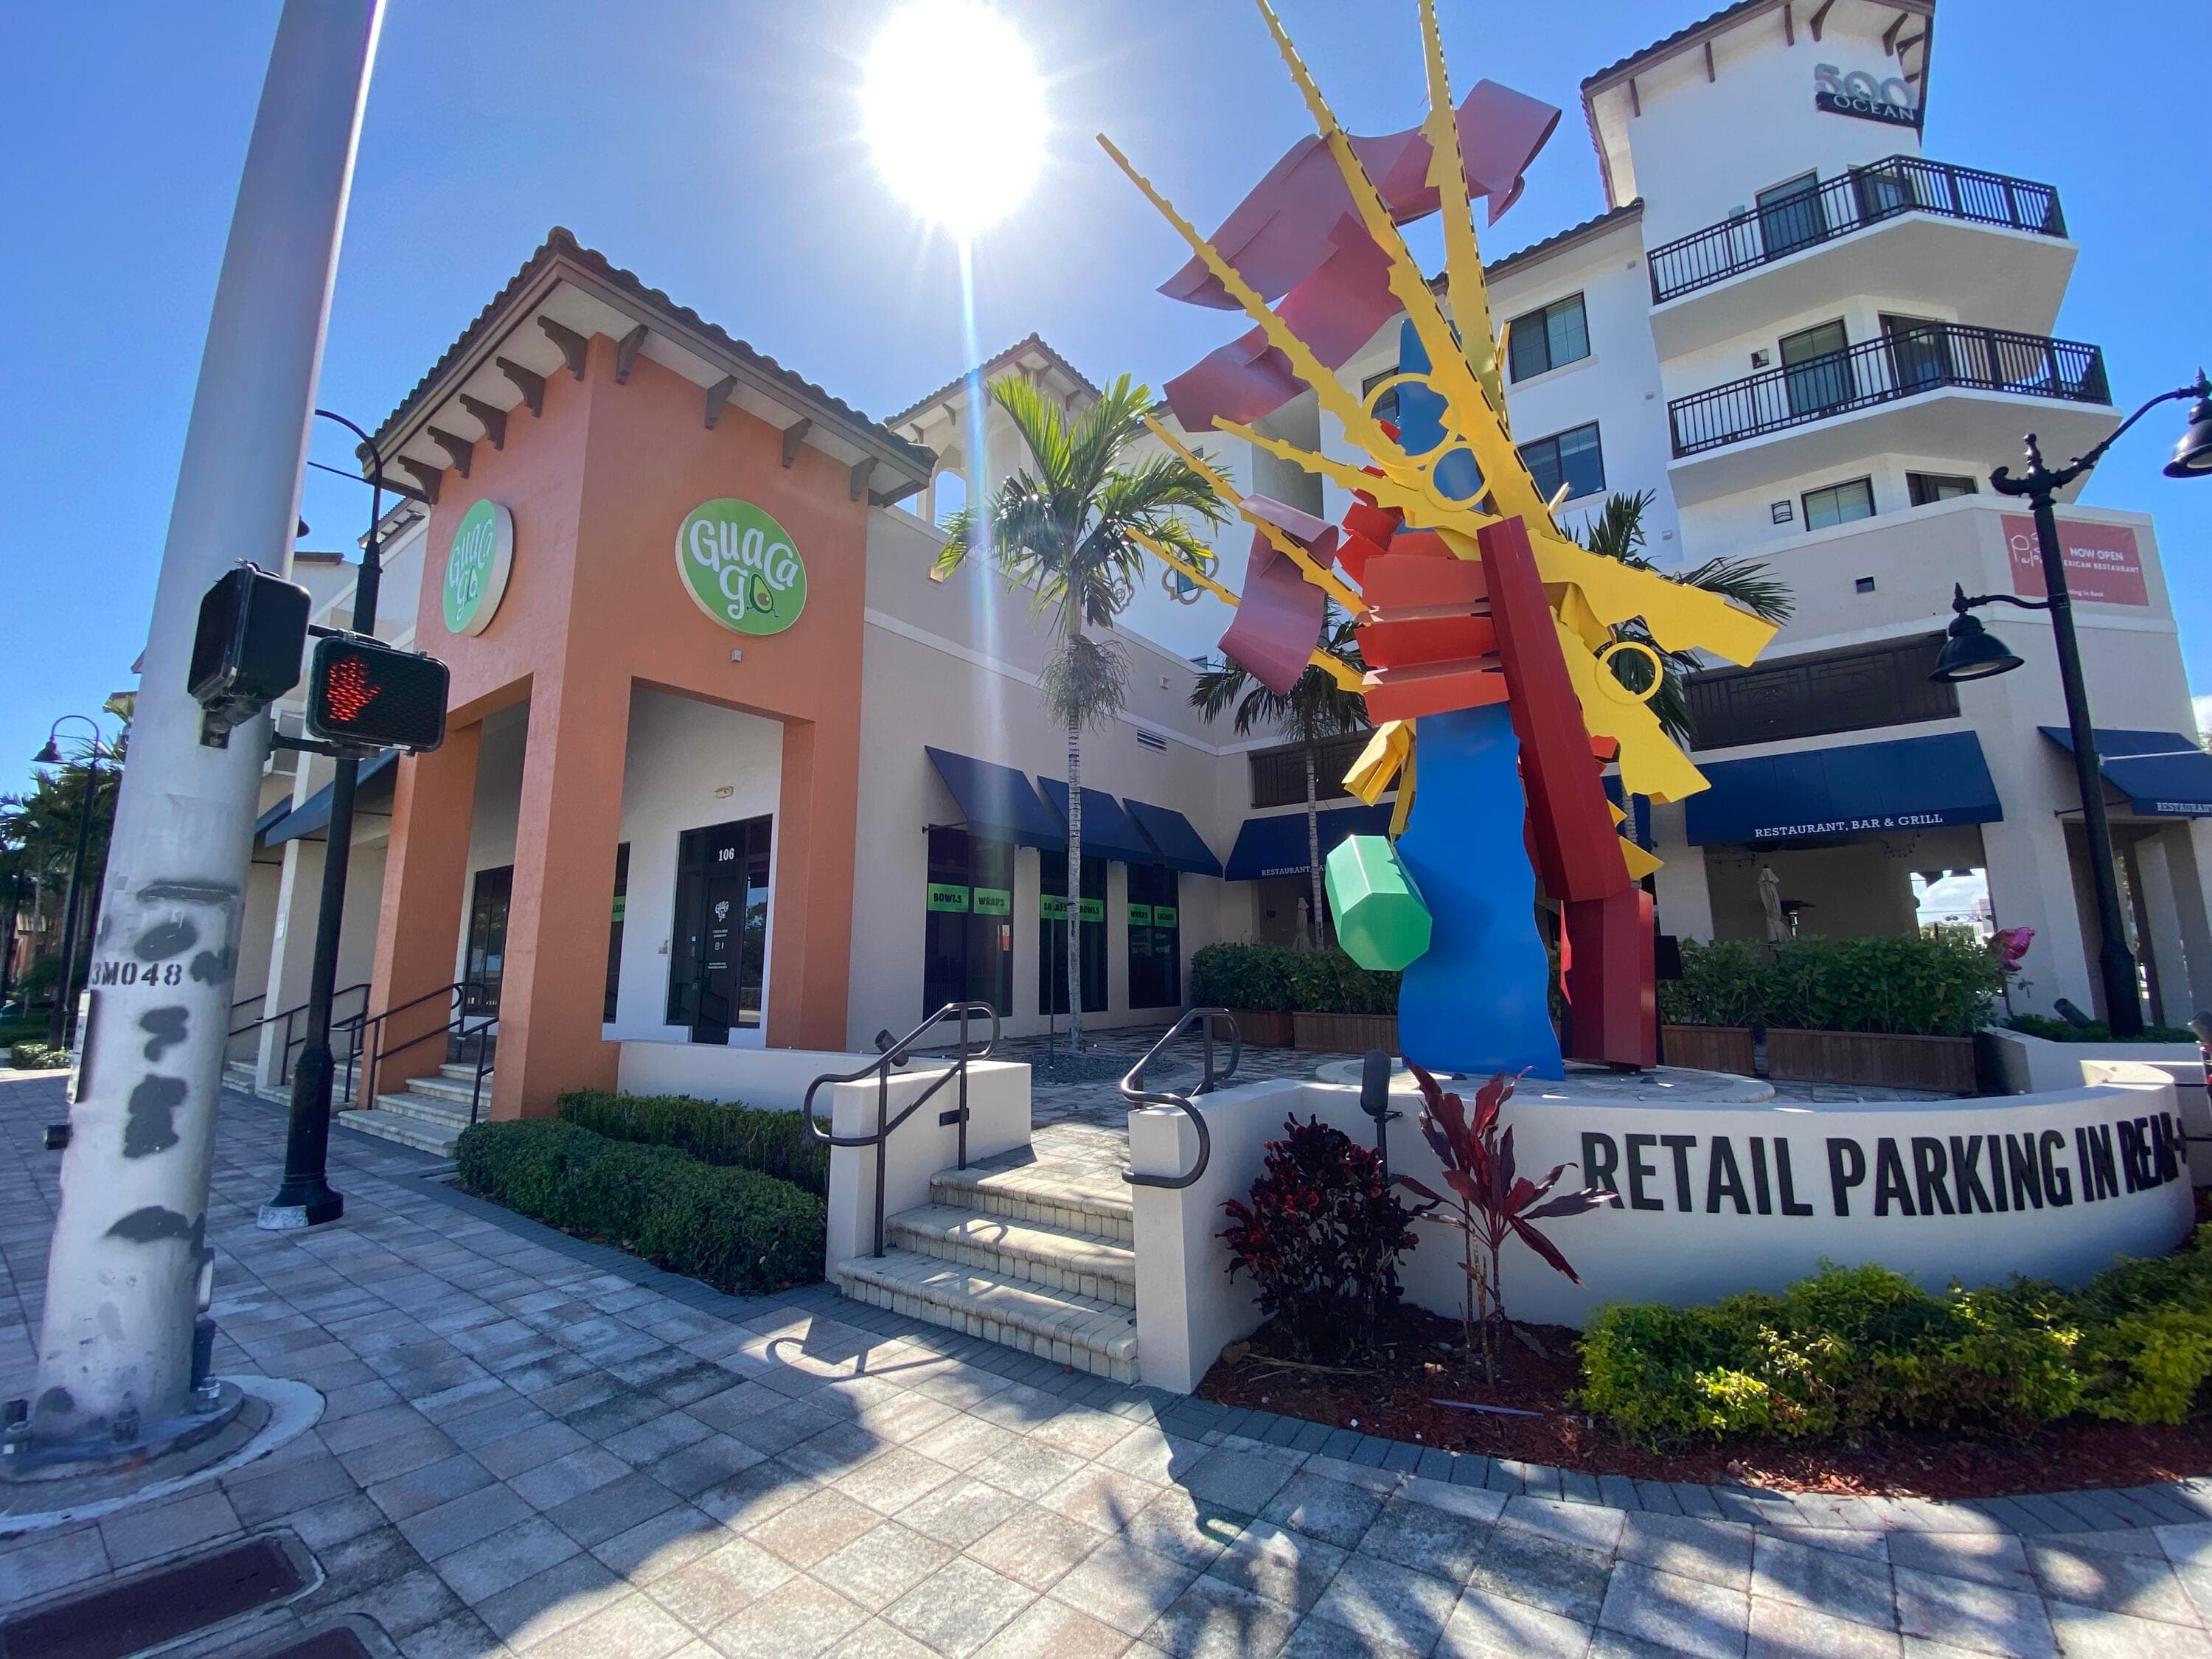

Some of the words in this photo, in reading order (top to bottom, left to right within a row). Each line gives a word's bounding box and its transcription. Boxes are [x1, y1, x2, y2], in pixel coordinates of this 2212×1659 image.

[1815, 63, 1919, 109] 500
[1833, 95, 1915, 121] OCEAN
[2069, 547, 2096, 559] NOW
[2096, 550, 2124, 561] OPEN
[2064, 560, 2092, 568] EXICAN
[1755, 821, 1848, 838] RESTAURANT,
[1851, 818, 1880, 830] BAR
[1884, 818, 1894, 827] &
[1898, 813, 1943, 826] GRILL
[718, 847, 734, 861] 106
[933, 893, 962, 904] BOWLS
[978, 897, 1005, 906] WRAPS
[1130, 911, 1148, 919] WRAPS
[91, 961, 182, 987] 3M048
[1581, 1132, 1813, 1216] RETAIL
[1826, 1129, 2073, 1217] PARKING
[2074, 1124, 2120, 1202] IN
